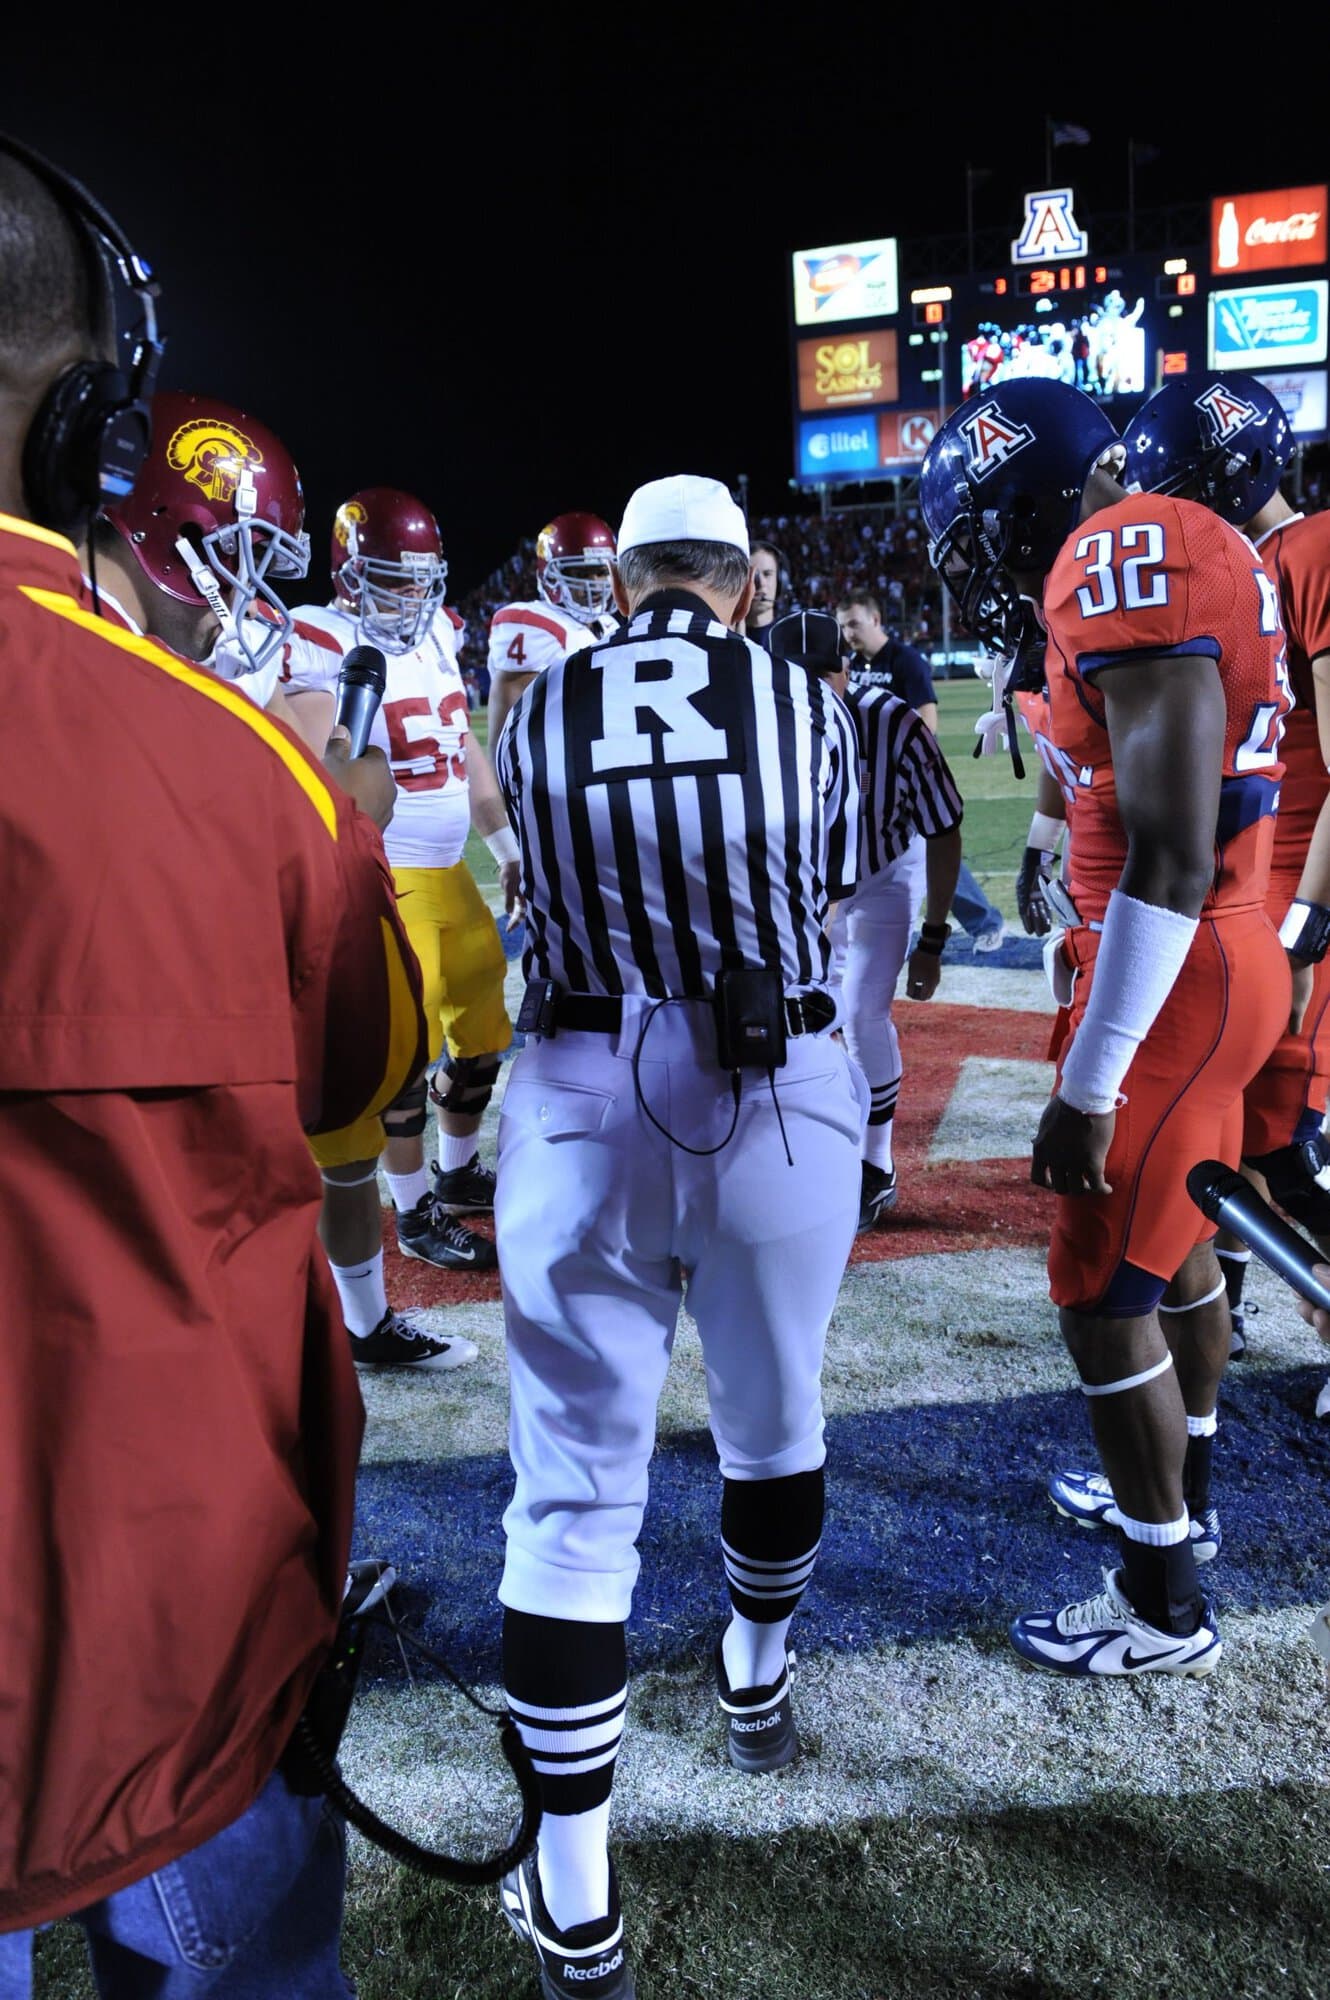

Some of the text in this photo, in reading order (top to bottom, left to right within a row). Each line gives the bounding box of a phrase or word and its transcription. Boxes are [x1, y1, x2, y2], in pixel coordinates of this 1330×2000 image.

[1012, 188, 1088, 264] A
[816, 341, 881, 375] SOL
[959, 400, 1036, 484] A
[1194, 383, 1262, 447] A
[1074, 523, 1169, 619] 32
[507, 632, 527, 665] 4
[383, 691, 470, 792] 53
[590, 638, 729, 773] R
[731, 1711, 782, 1733] Reebok
